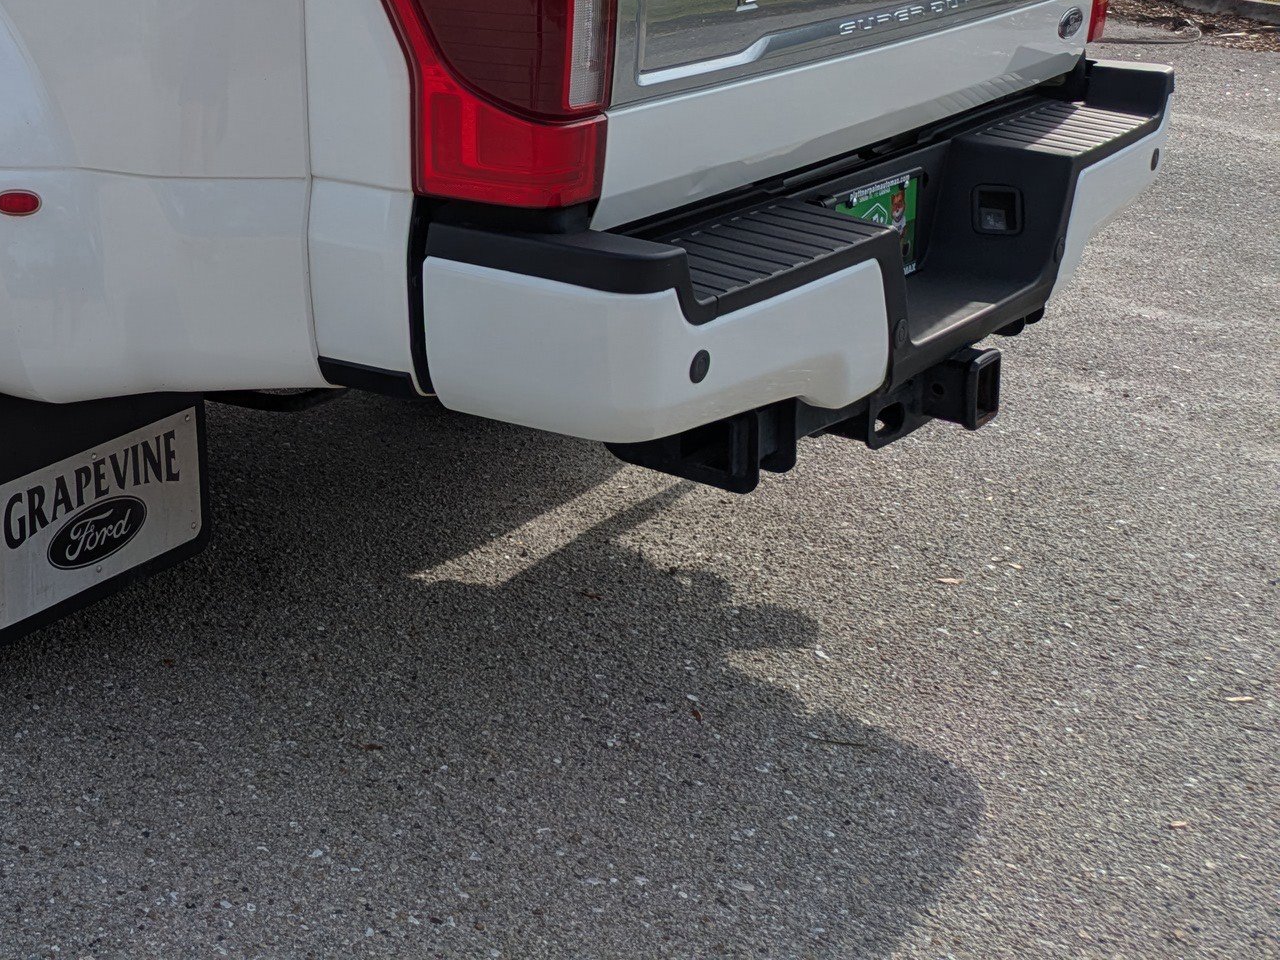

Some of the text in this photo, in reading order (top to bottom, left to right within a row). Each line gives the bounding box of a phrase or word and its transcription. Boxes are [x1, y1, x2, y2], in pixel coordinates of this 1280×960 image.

[838, 4, 926, 36] SUPER
[3, 429, 181, 550] GRAPEVINE
[65, 507, 132, 561] Ford
